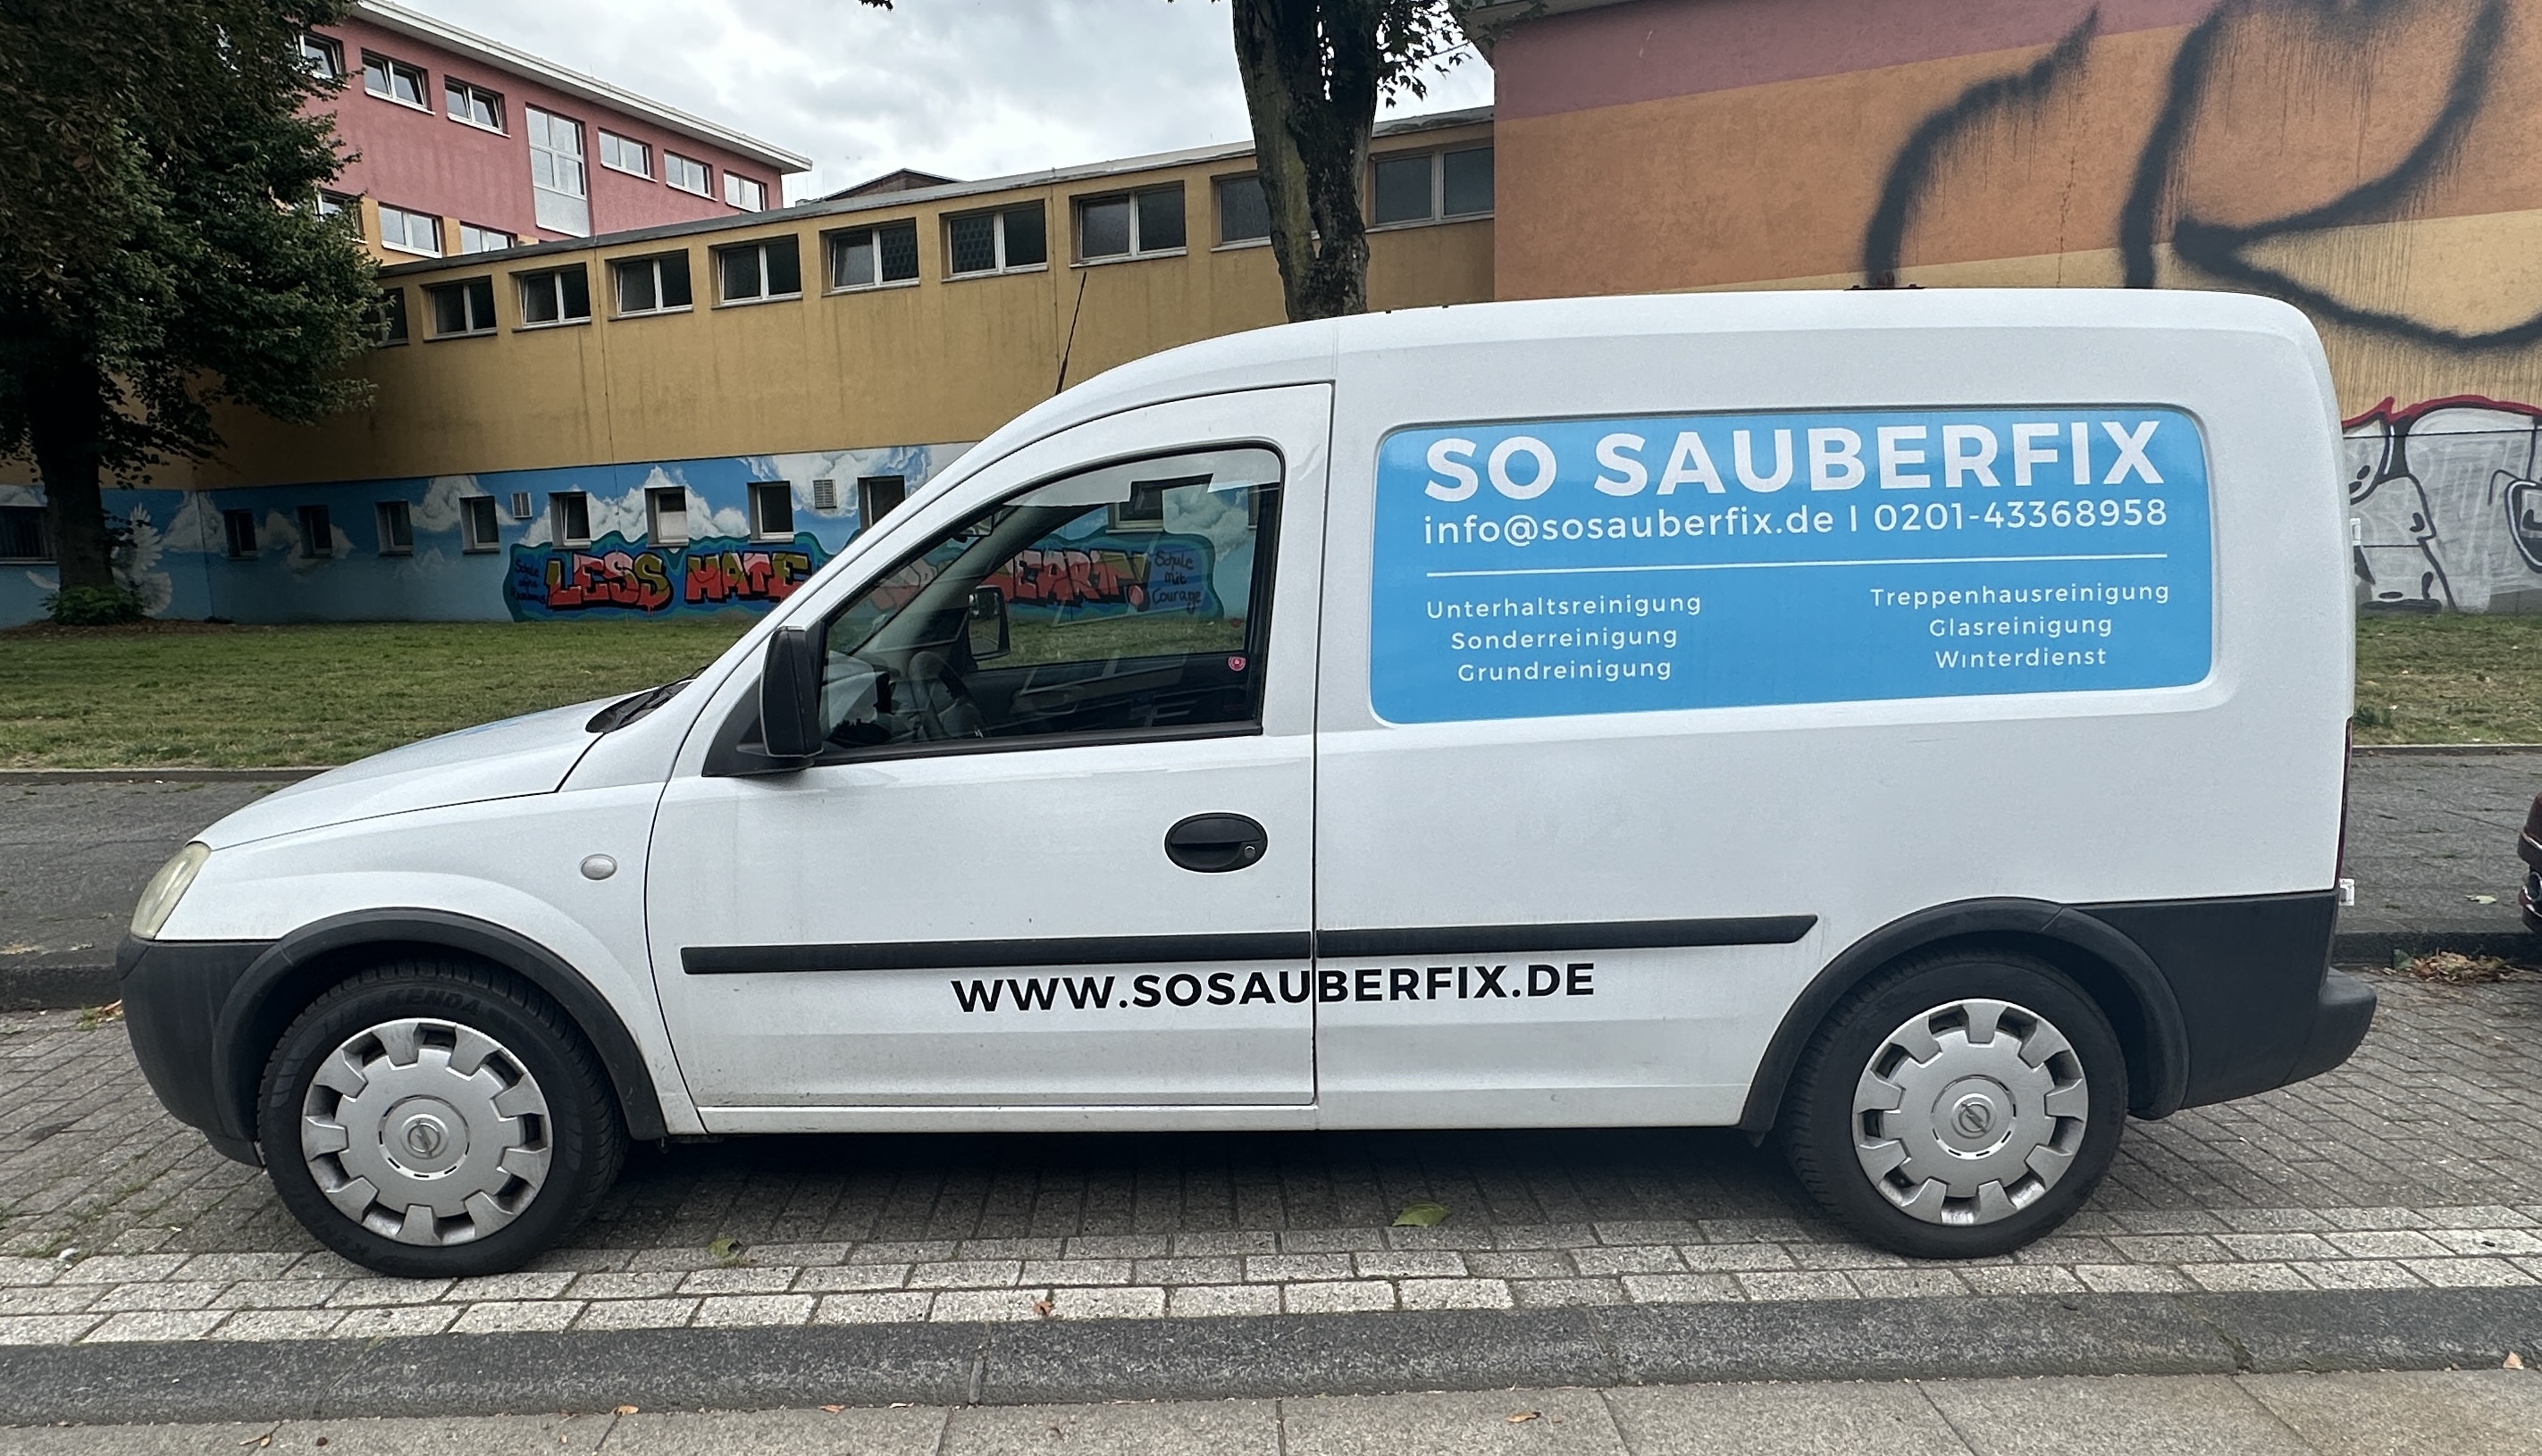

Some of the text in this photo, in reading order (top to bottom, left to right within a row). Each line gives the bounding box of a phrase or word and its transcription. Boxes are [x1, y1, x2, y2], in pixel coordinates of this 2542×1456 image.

[1424, 420, 2164, 502] SO SAUBERFIX
[1424, 505, 1833, 547] info@sosauberfix.de
[1874, 498, 2168, 531] 0201-43368958
[546, 551, 673, 611] LESS
[684, 551, 812, 603] HATE
[1426, 593, 1703, 619] Unterhaltsreinigung
[1869, 582, 2169, 610] Treppenhausreinigung
[1450, 626, 1679, 650] Sonderreinigung
[1928, 615, 2112, 638] Glasreinigung
[1457, 658, 1673, 682] Grundreinigung
[1934, 647, 2107, 669] Winterdienst
[950, 962, 1596, 1014] WWW.SOSAUBERFIX.DE
